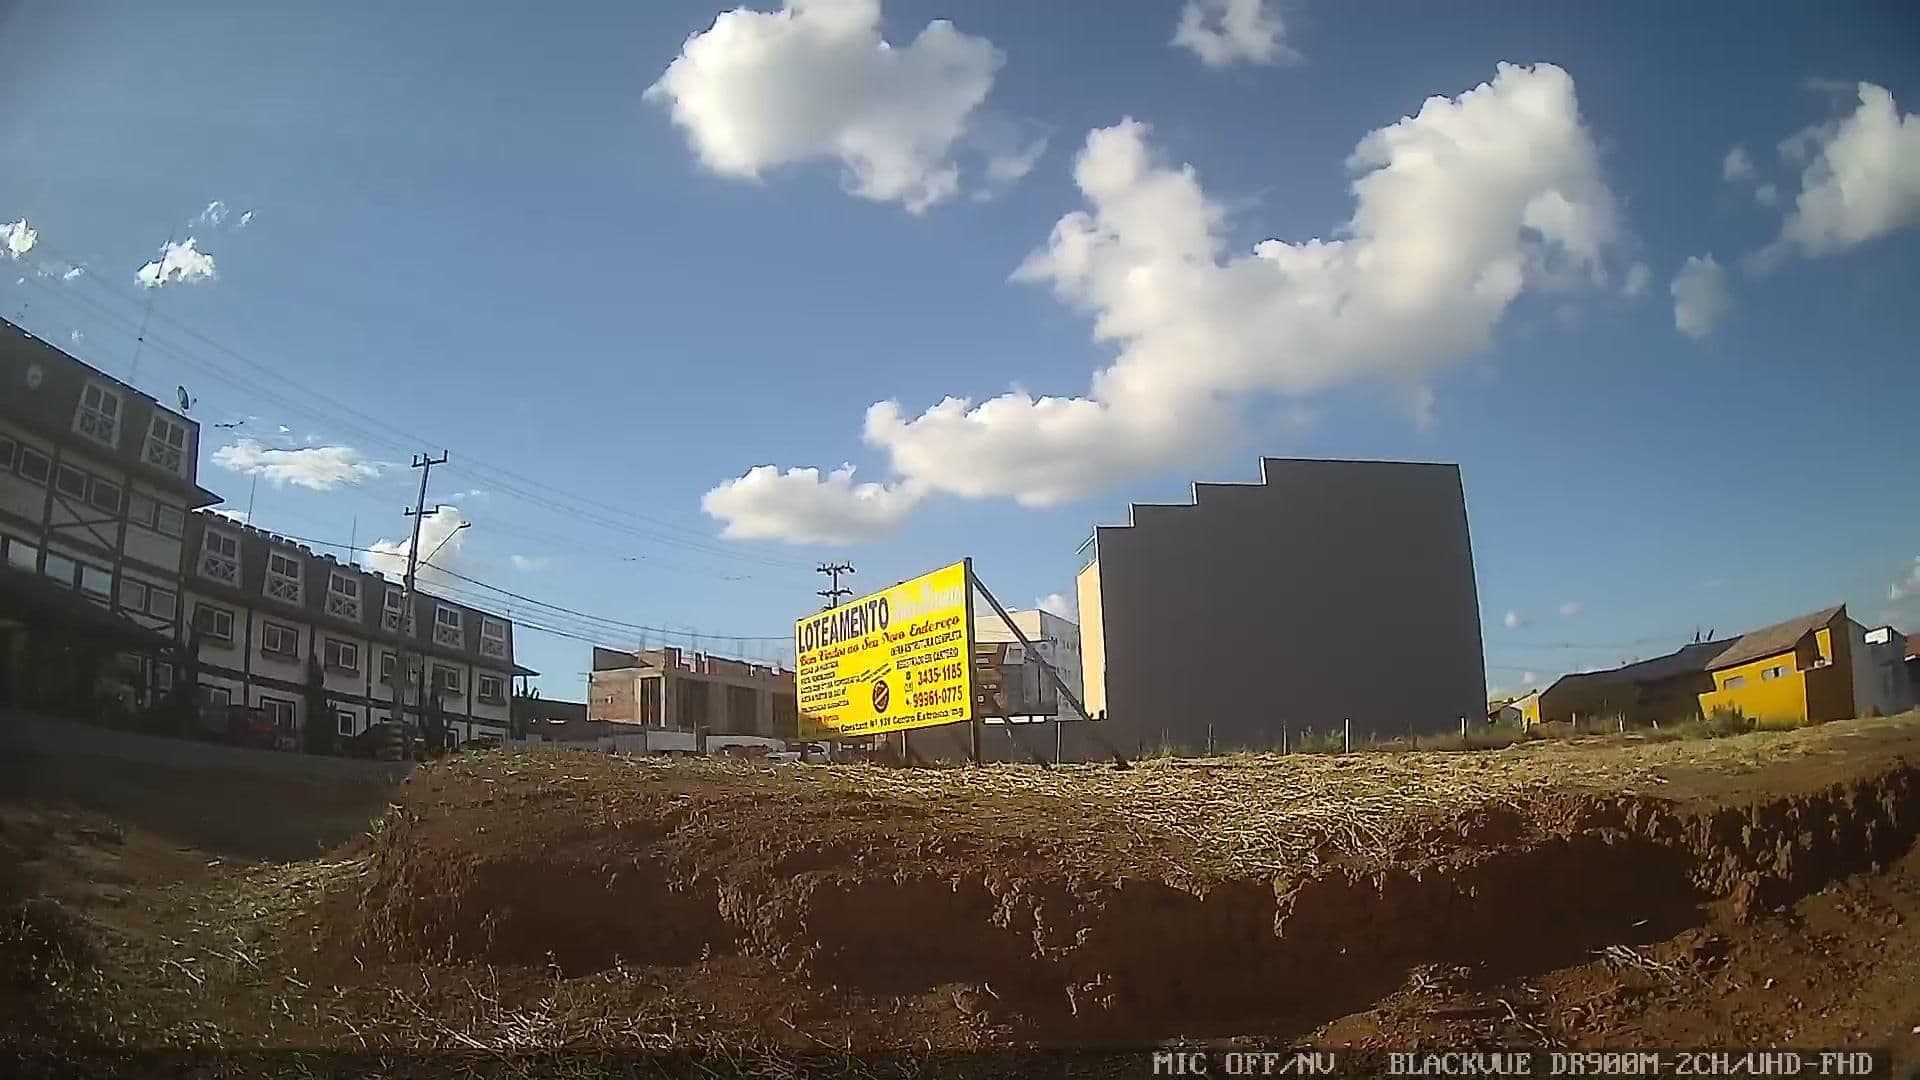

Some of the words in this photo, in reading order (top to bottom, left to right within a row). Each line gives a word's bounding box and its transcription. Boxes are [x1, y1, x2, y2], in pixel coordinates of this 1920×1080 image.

[799, 597, 889, 653] LOTEAMENTO
[862, 636, 879, 650] Seu
[909, 615, 960, 636] Endereço
[917, 662, 962, 686] 3435-1185
